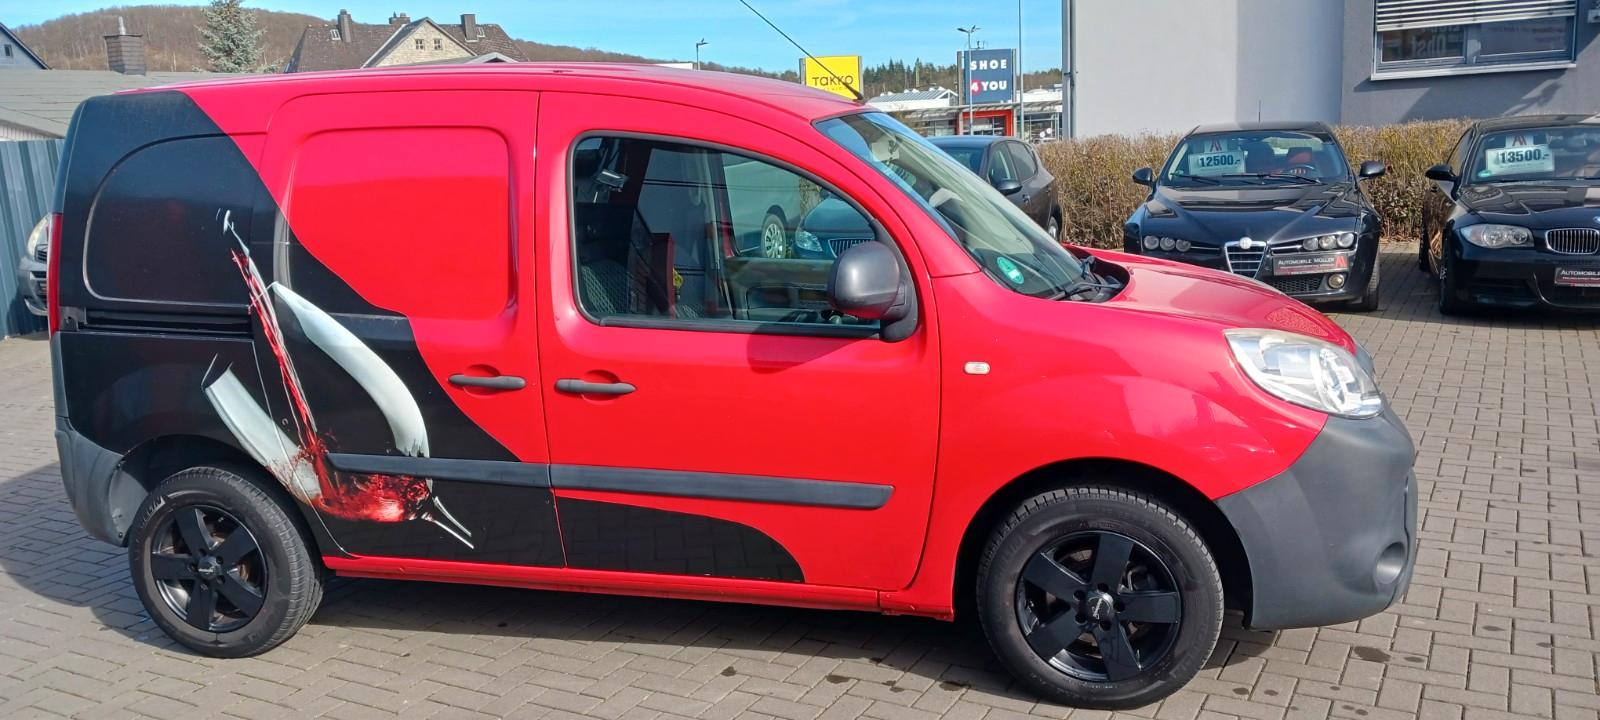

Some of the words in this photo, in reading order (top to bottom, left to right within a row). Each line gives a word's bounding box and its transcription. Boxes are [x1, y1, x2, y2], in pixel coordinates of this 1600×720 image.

[969, 59, 1007, 71] SHOE
[971, 82, 980, 92] 4
[981, 80, 1007, 92] YOU
